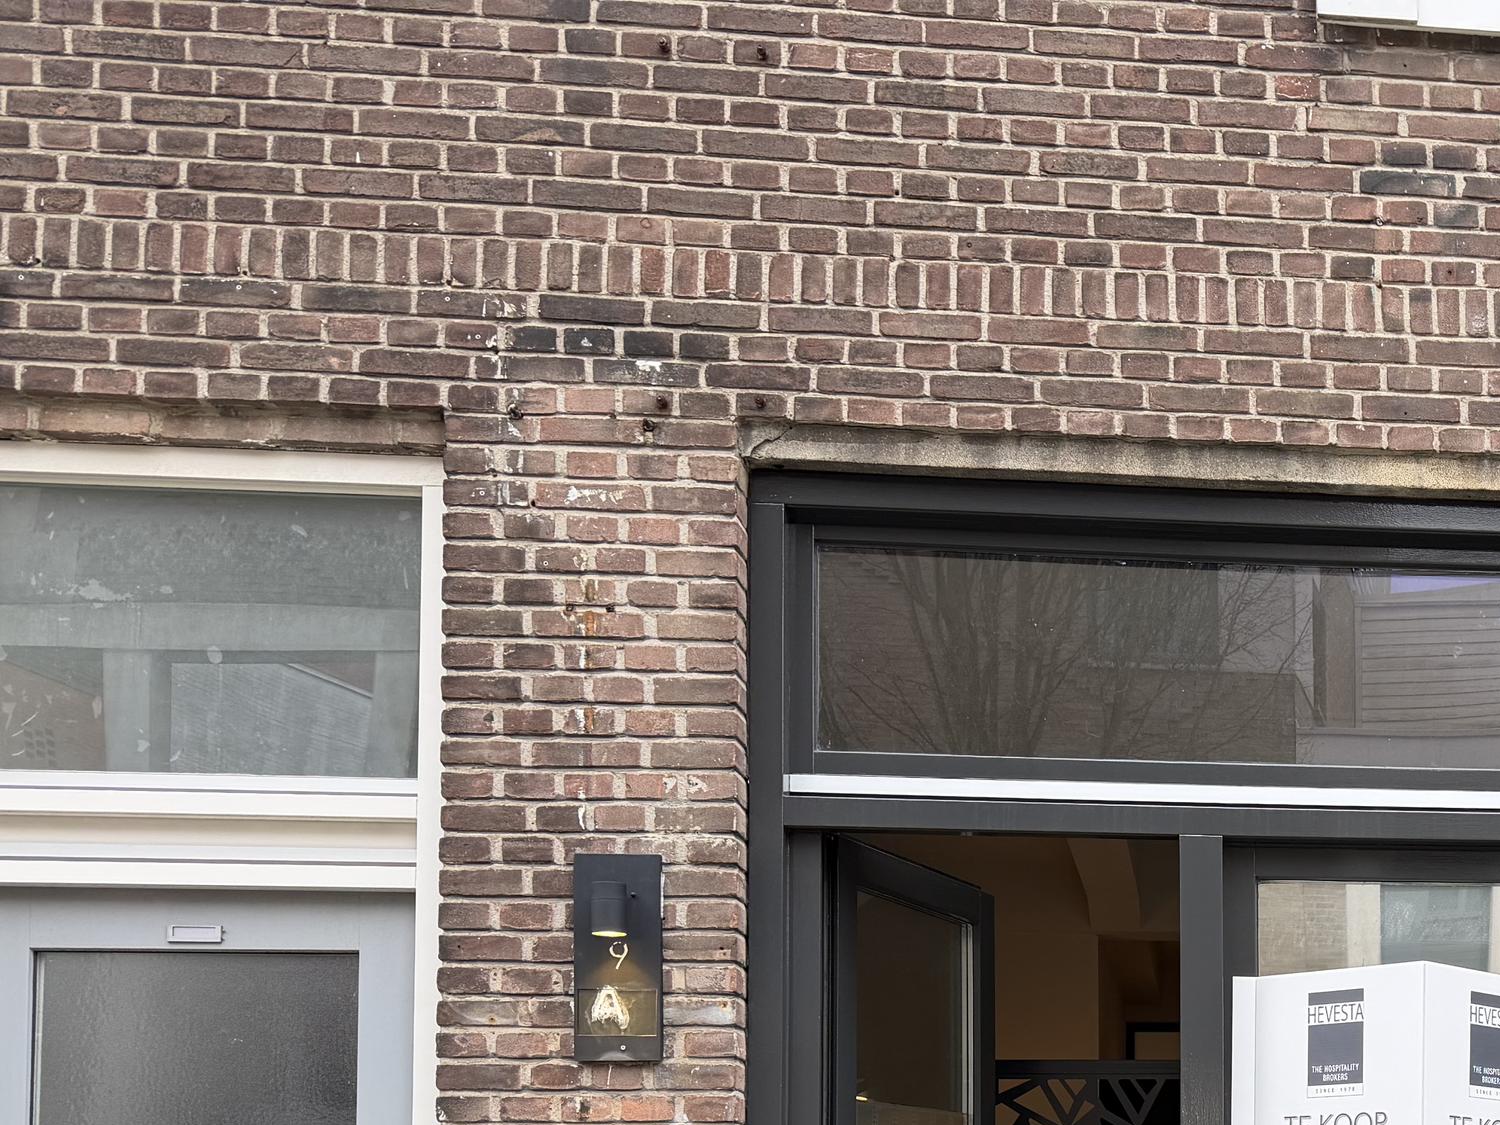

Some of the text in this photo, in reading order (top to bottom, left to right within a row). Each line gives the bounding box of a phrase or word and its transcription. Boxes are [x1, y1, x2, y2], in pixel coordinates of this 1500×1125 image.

[609, 941, 629, 970] 9
[591, 984, 630, 1030] A
[1307, 1002, 1365, 1025] HEVESTA
[1311, 1062, 1360, 1074] THE HOSPITALITY
[1473, 1065, 1482, 1075] THE
[1322, 1072, 1349, 1082] BROKERS
[1315, 1087, 1335, 1095] SINCE
